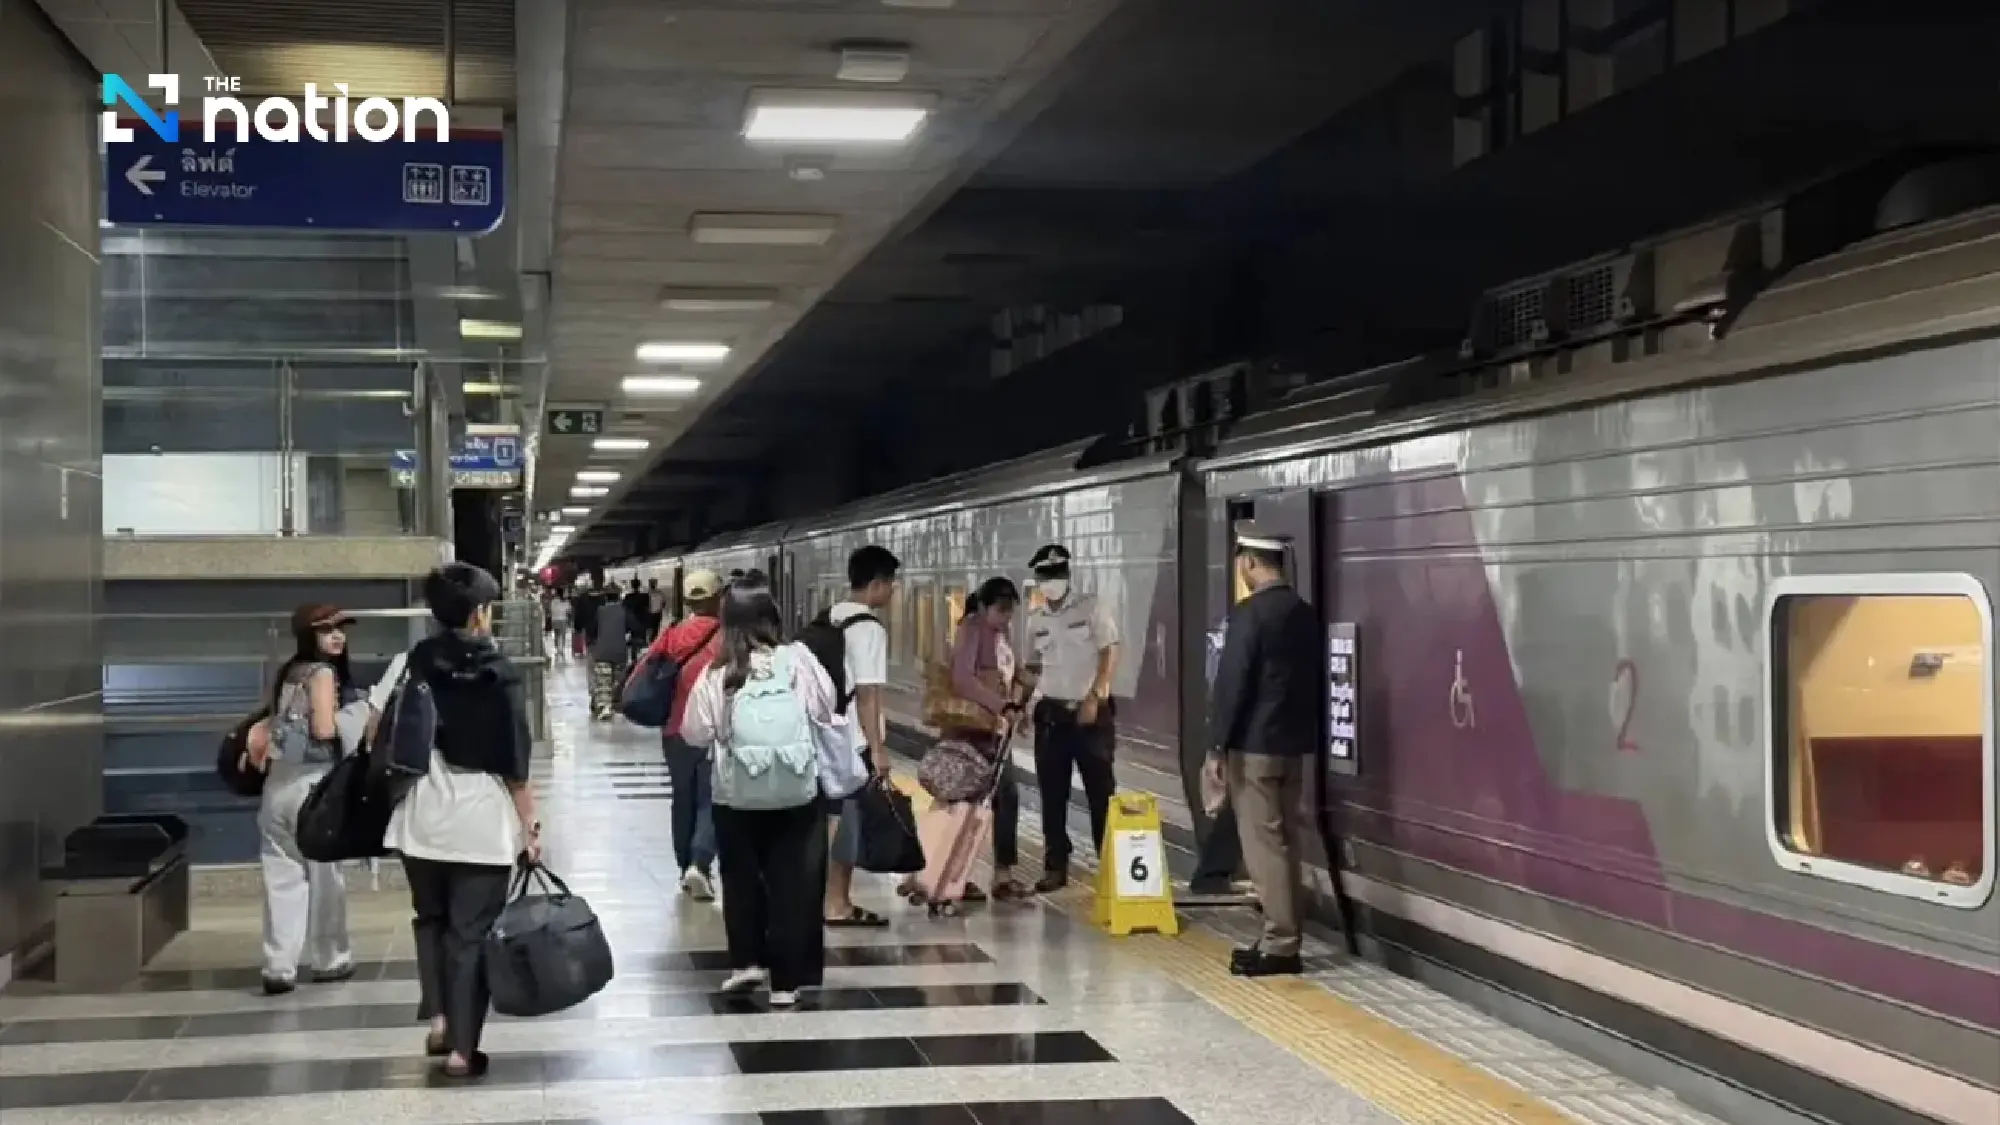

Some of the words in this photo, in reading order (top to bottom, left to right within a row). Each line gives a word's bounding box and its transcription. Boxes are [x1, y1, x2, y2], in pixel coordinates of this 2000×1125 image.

[181, 180, 258, 198] Elevator
[1615, 659, 1640, 751] 2
[1130, 855, 1149, 882] 6
